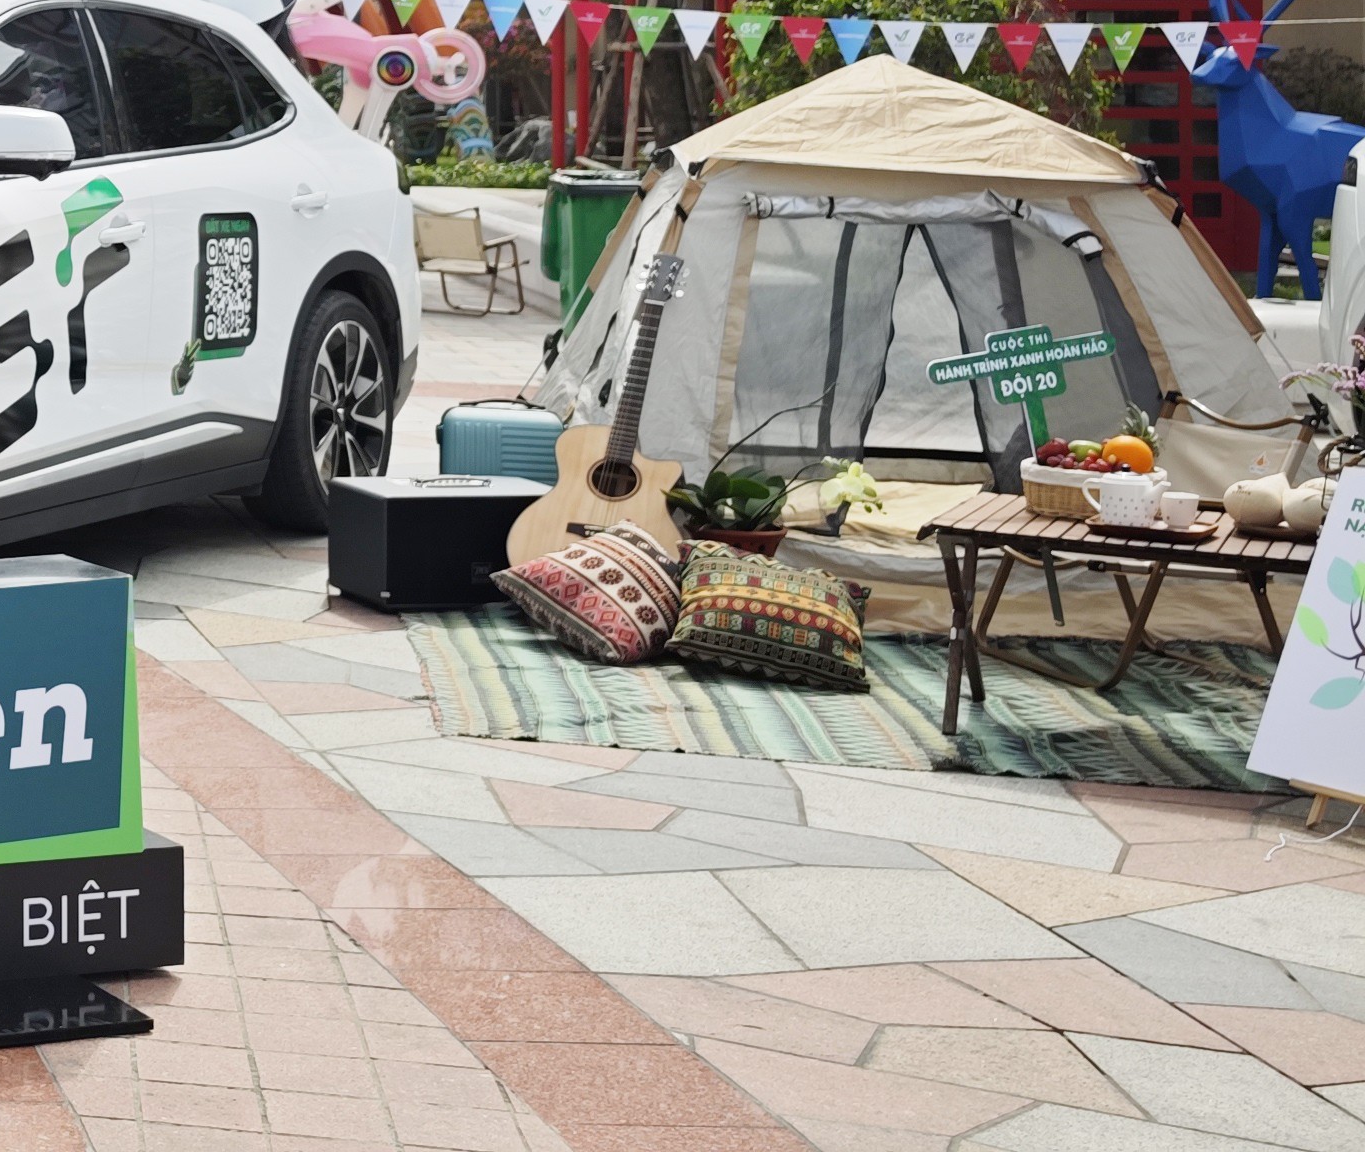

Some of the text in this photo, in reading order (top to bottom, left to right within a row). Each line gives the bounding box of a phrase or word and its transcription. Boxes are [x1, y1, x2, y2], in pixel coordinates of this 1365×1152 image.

[991, 332, 1048, 353] CUỘC THI
[936, 339, 1108, 381] HÀNH TRÌNH XANH HOÀN HẢO
[1000, 371, 1057, 398] ĐỘI 20
[23, 879, 140, 955] BIỆT
